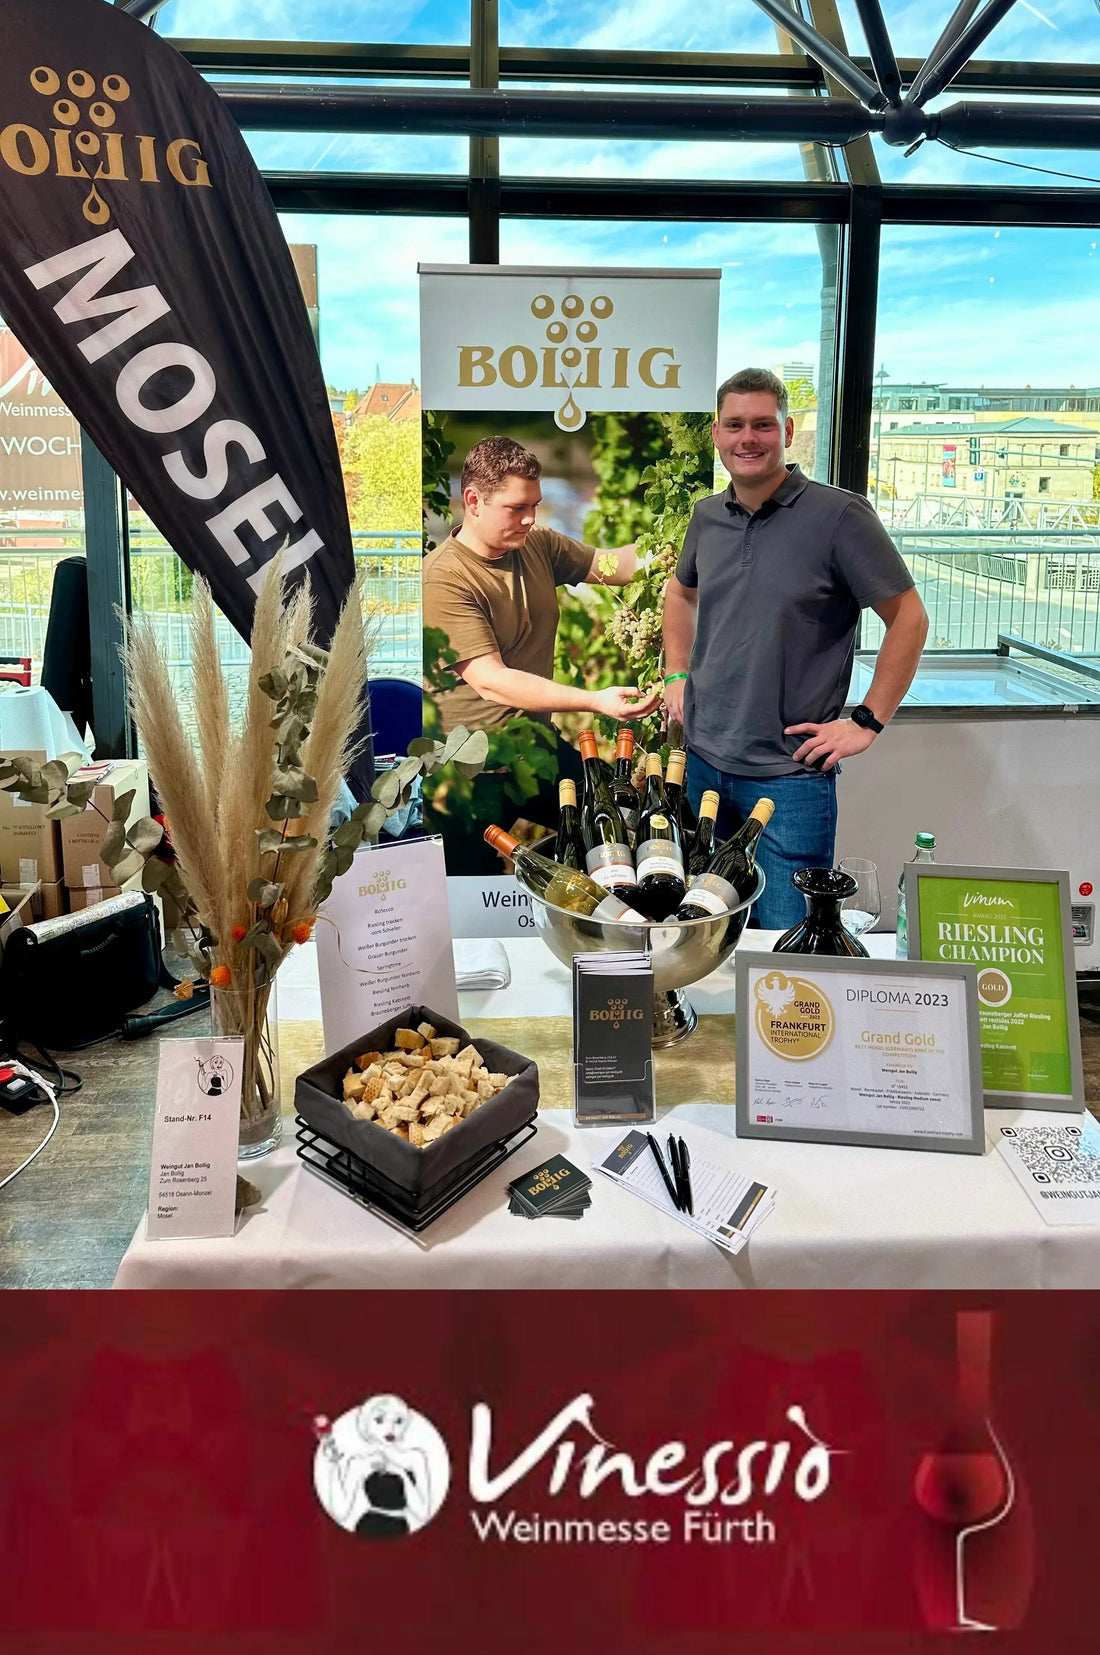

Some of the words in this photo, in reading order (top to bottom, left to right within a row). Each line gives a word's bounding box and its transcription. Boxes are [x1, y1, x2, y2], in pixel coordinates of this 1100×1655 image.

[456, 344, 682, 389] BOLLIG
[24, 229, 324, 600] MOSEL
[937, 922, 1044, 946] RIESLING
[938, 943, 1044, 964] CHAMPION
[982, 984, 1004, 992] GOLD
[846, 989, 911, 1004] DIPLOMA
[914, 993, 949, 1007] 2023
[590, 1009, 644, 1021] BOLLIG
[770, 1020, 826, 1032] FRANKFURT
[770, 1030, 821, 1038] INTERNATIONAL
[861, 1030, 900, 1044] Grand
[904, 1033, 935, 1046] Gold
[195, 1162, 211, 1170] Bollig
[171, 1170, 184, 1178] Bollig
